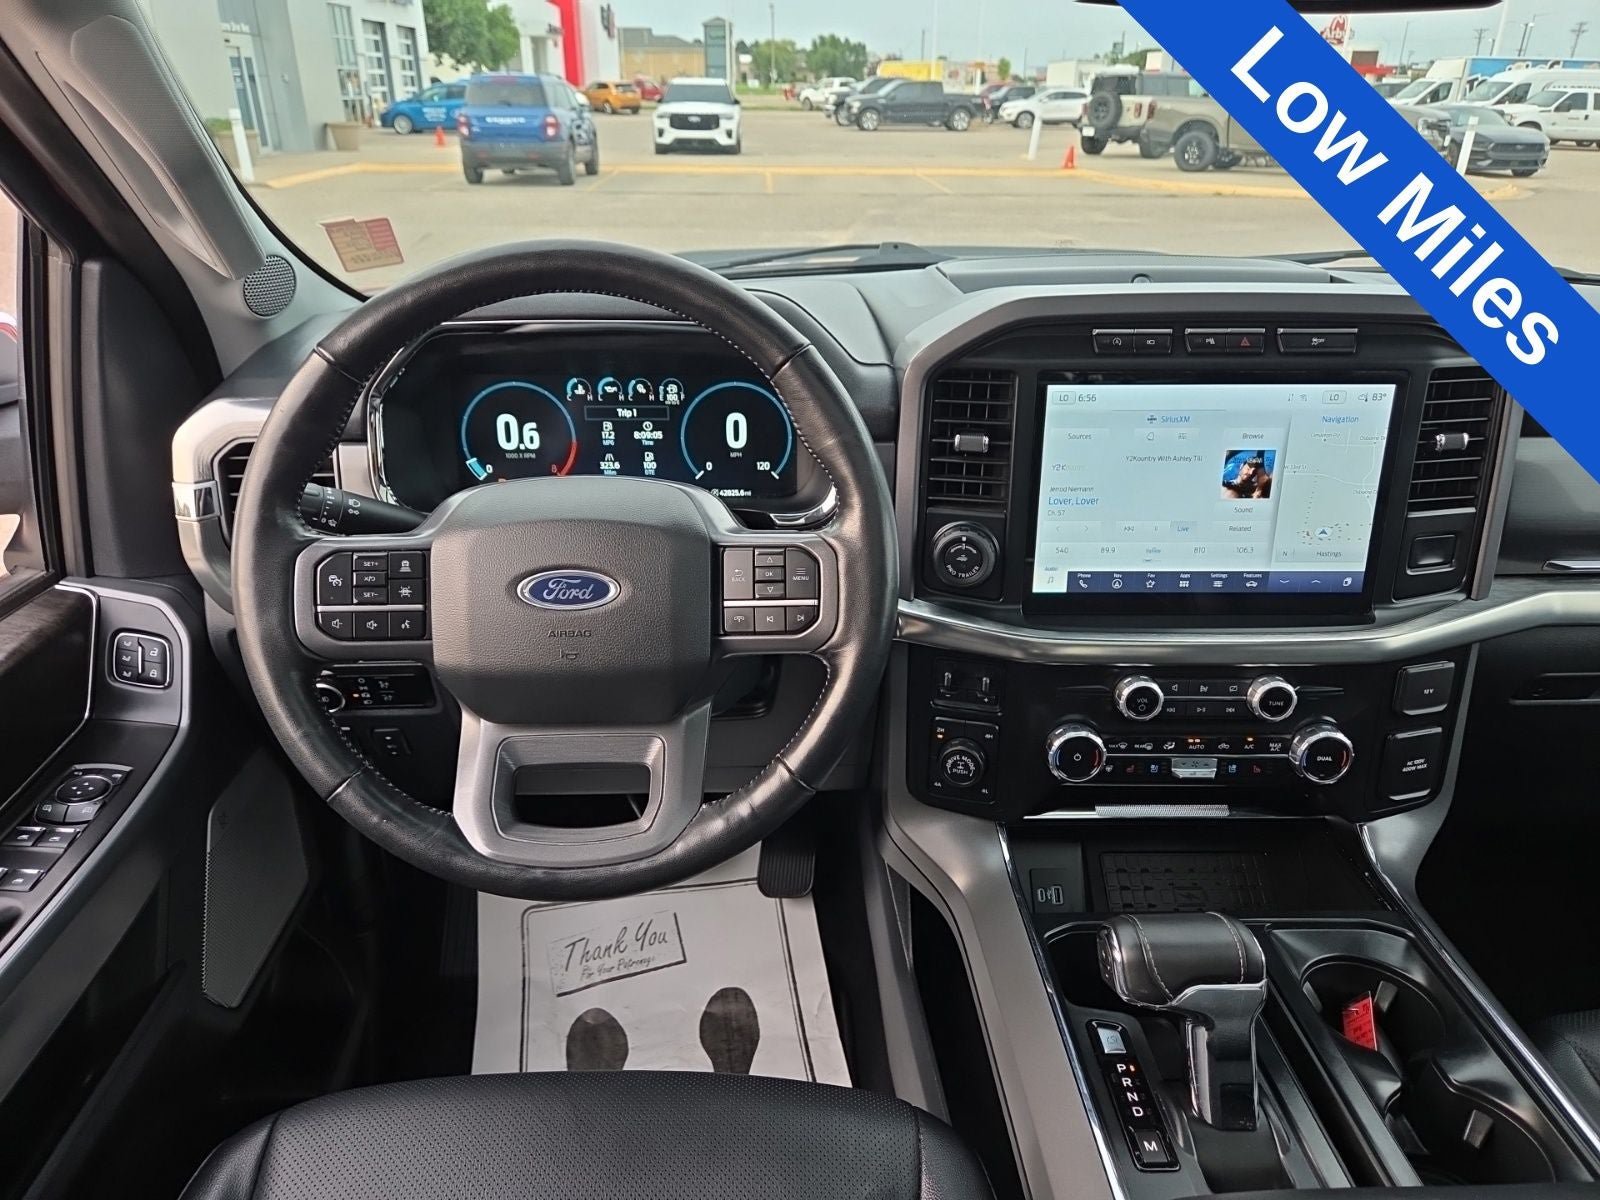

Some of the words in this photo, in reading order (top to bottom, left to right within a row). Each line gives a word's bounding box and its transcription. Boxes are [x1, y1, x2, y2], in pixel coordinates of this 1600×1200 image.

[1059, 394, 1069, 402] LO
[1078, 393, 1097, 402] 6:56
[617, 408, 633, 418] Trip
[1160, 415, 1191, 423] SiriusXM
[1322, 415, 1359, 424] Navigation
[496, 413, 540, 451] 0.6
[601, 431, 615, 440] 17.2
[725, 412, 748, 449] 0
[1068, 432, 1092, 440] Sources
[1242, 432, 1264, 440] Browse
[1126, 455, 1156, 463] Y2Kountry
[1172, 455, 1192, 463] Ashley
[485, 464, 493, 474] 0
[600, 462, 620, 470] 323.6
[643, 462, 657, 470] 100
[705, 461, 713, 471] 0
[757, 461, 770, 471] 120
[1048, 496, 1073, 506] Lover,
[1075, 496, 1099, 506] Lover
[1236, 546, 1254, 554] 106.3
[1316, 551, 1342, 559] Hastings
[958, 565, 980, 578] TRAILER
[543, 577, 595, 600] Ford
[548, 629, 592, 639] AIRBAG
[946, 755, 961, 768] DRIVE
[565, 926, 628, 972] Thank
[635, 919, 668, 951] You
[1116, 1063, 1127, 1073] P
[1121, 1077, 1133, 1087] R
[1127, 1092, 1138, 1102] N
[1132, 1106, 1144, 1117] D
[1143, 1141, 1158, 1152] M
